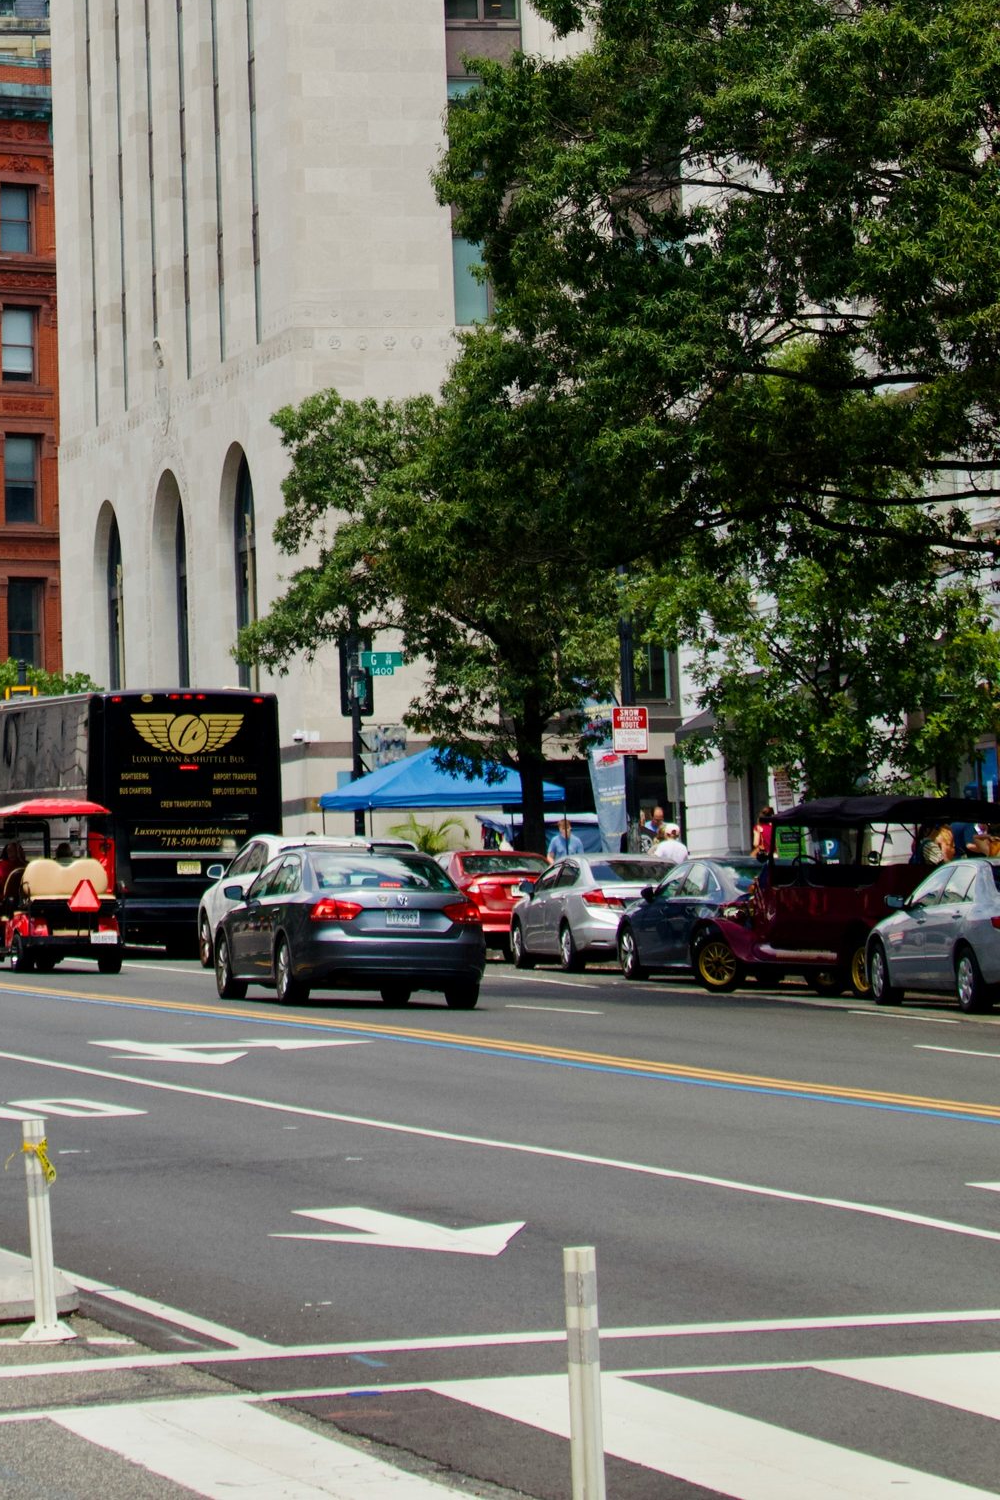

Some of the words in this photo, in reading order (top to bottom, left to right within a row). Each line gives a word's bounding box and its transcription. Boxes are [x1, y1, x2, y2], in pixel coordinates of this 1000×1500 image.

[371, 654, 377, 665] G
[620, 721, 640, 729] ROUTE
[132, 755, 163, 763] LUXURY
[165, 755, 182, 763] VAN
[183, 755, 190, 763] &
[192, 755, 227, 763] SHUTTLE
[120, 772, 150, 780] SIGHTSEEING
[213, 773, 231, 781] AIRPORT
[232, 773, 257, 781] TRANSFERS
[119, 787, 128, 795] BUS
[129, 787, 152, 795] CHARTERS
[160, 800, 173, 808] CREW
[174, 800, 212, 808] TRANSPORTATION
[134, 827, 247, 837] Luxuryvanandshuttlebus.com
[161, 837, 222, 846] 718-500-0082
[825, 840, 834, 855] P
